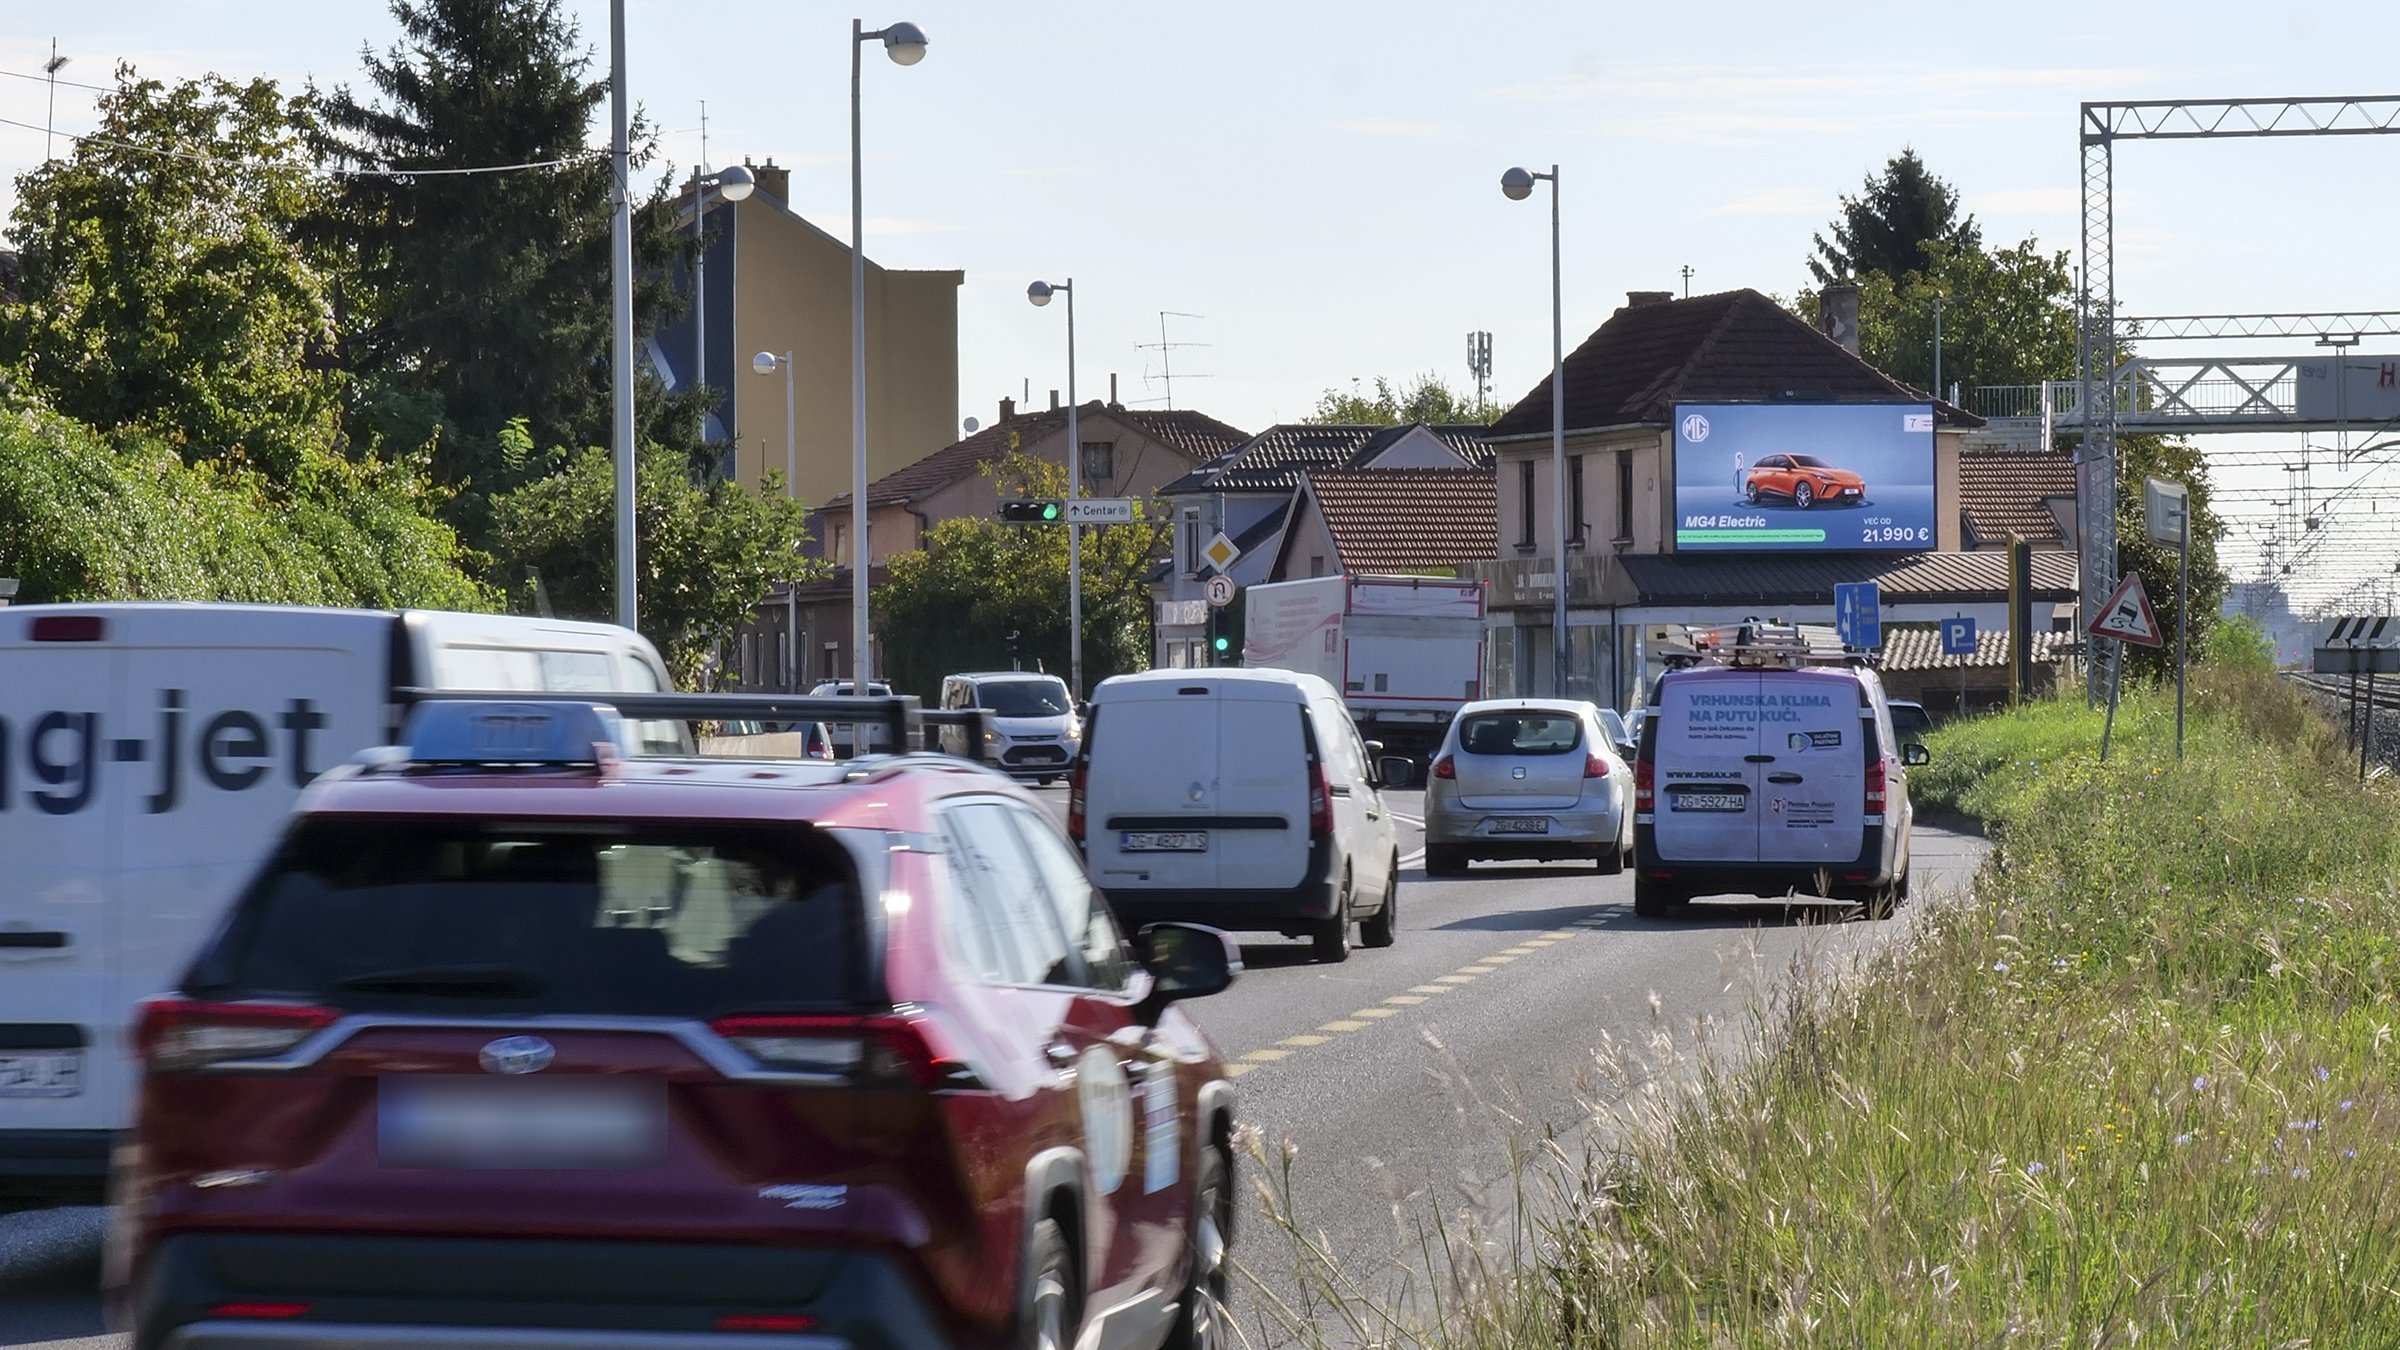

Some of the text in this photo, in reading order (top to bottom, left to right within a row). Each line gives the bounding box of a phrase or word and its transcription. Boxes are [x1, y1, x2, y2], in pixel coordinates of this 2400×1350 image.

[1083, 505, 1118, 516] Centar
[1685, 515, 1766, 528] MG4 Electric
[1880, 517, 1892, 525] OD
[1863, 527, 1929, 542] 21.990 €
[1951, 624, 1966, 648] P
[1689, 694, 1831, 708] VRHUNSKA KLIMA
[1689, 710, 1713, 722] NA
[1715, 710, 1758, 722] PUTU
[0, 688, 332, 815] g-jet
[1679, 795, 1694, 808] ZG
